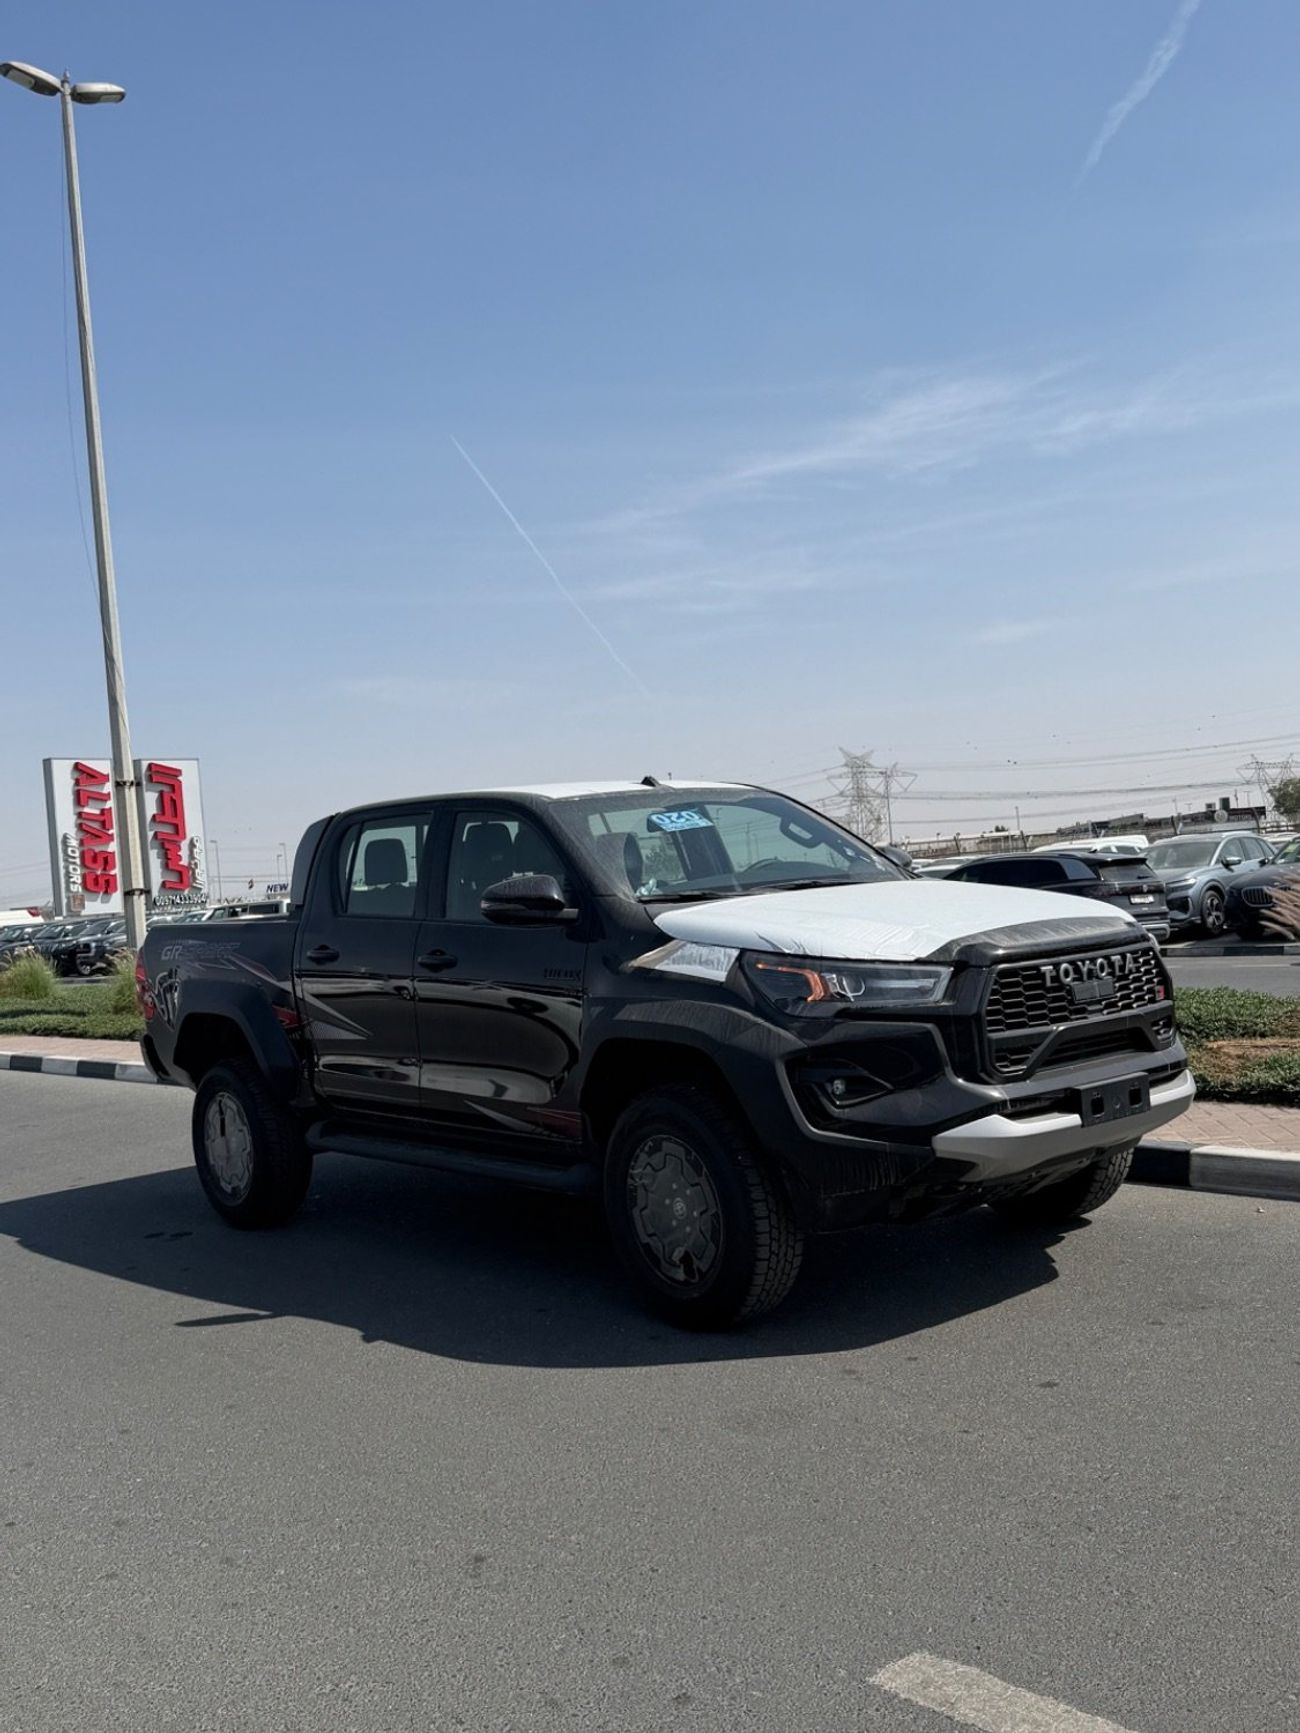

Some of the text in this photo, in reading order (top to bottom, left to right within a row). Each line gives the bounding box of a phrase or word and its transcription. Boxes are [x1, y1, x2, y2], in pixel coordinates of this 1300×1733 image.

[75, 762, 118, 895] ALTASS
[66, 832, 82, 893] MOTORS
[266, 883, 289, 893] NEW
[161, 945, 183, 960] GR
[1040, 953, 1137, 987] TOYOTA
